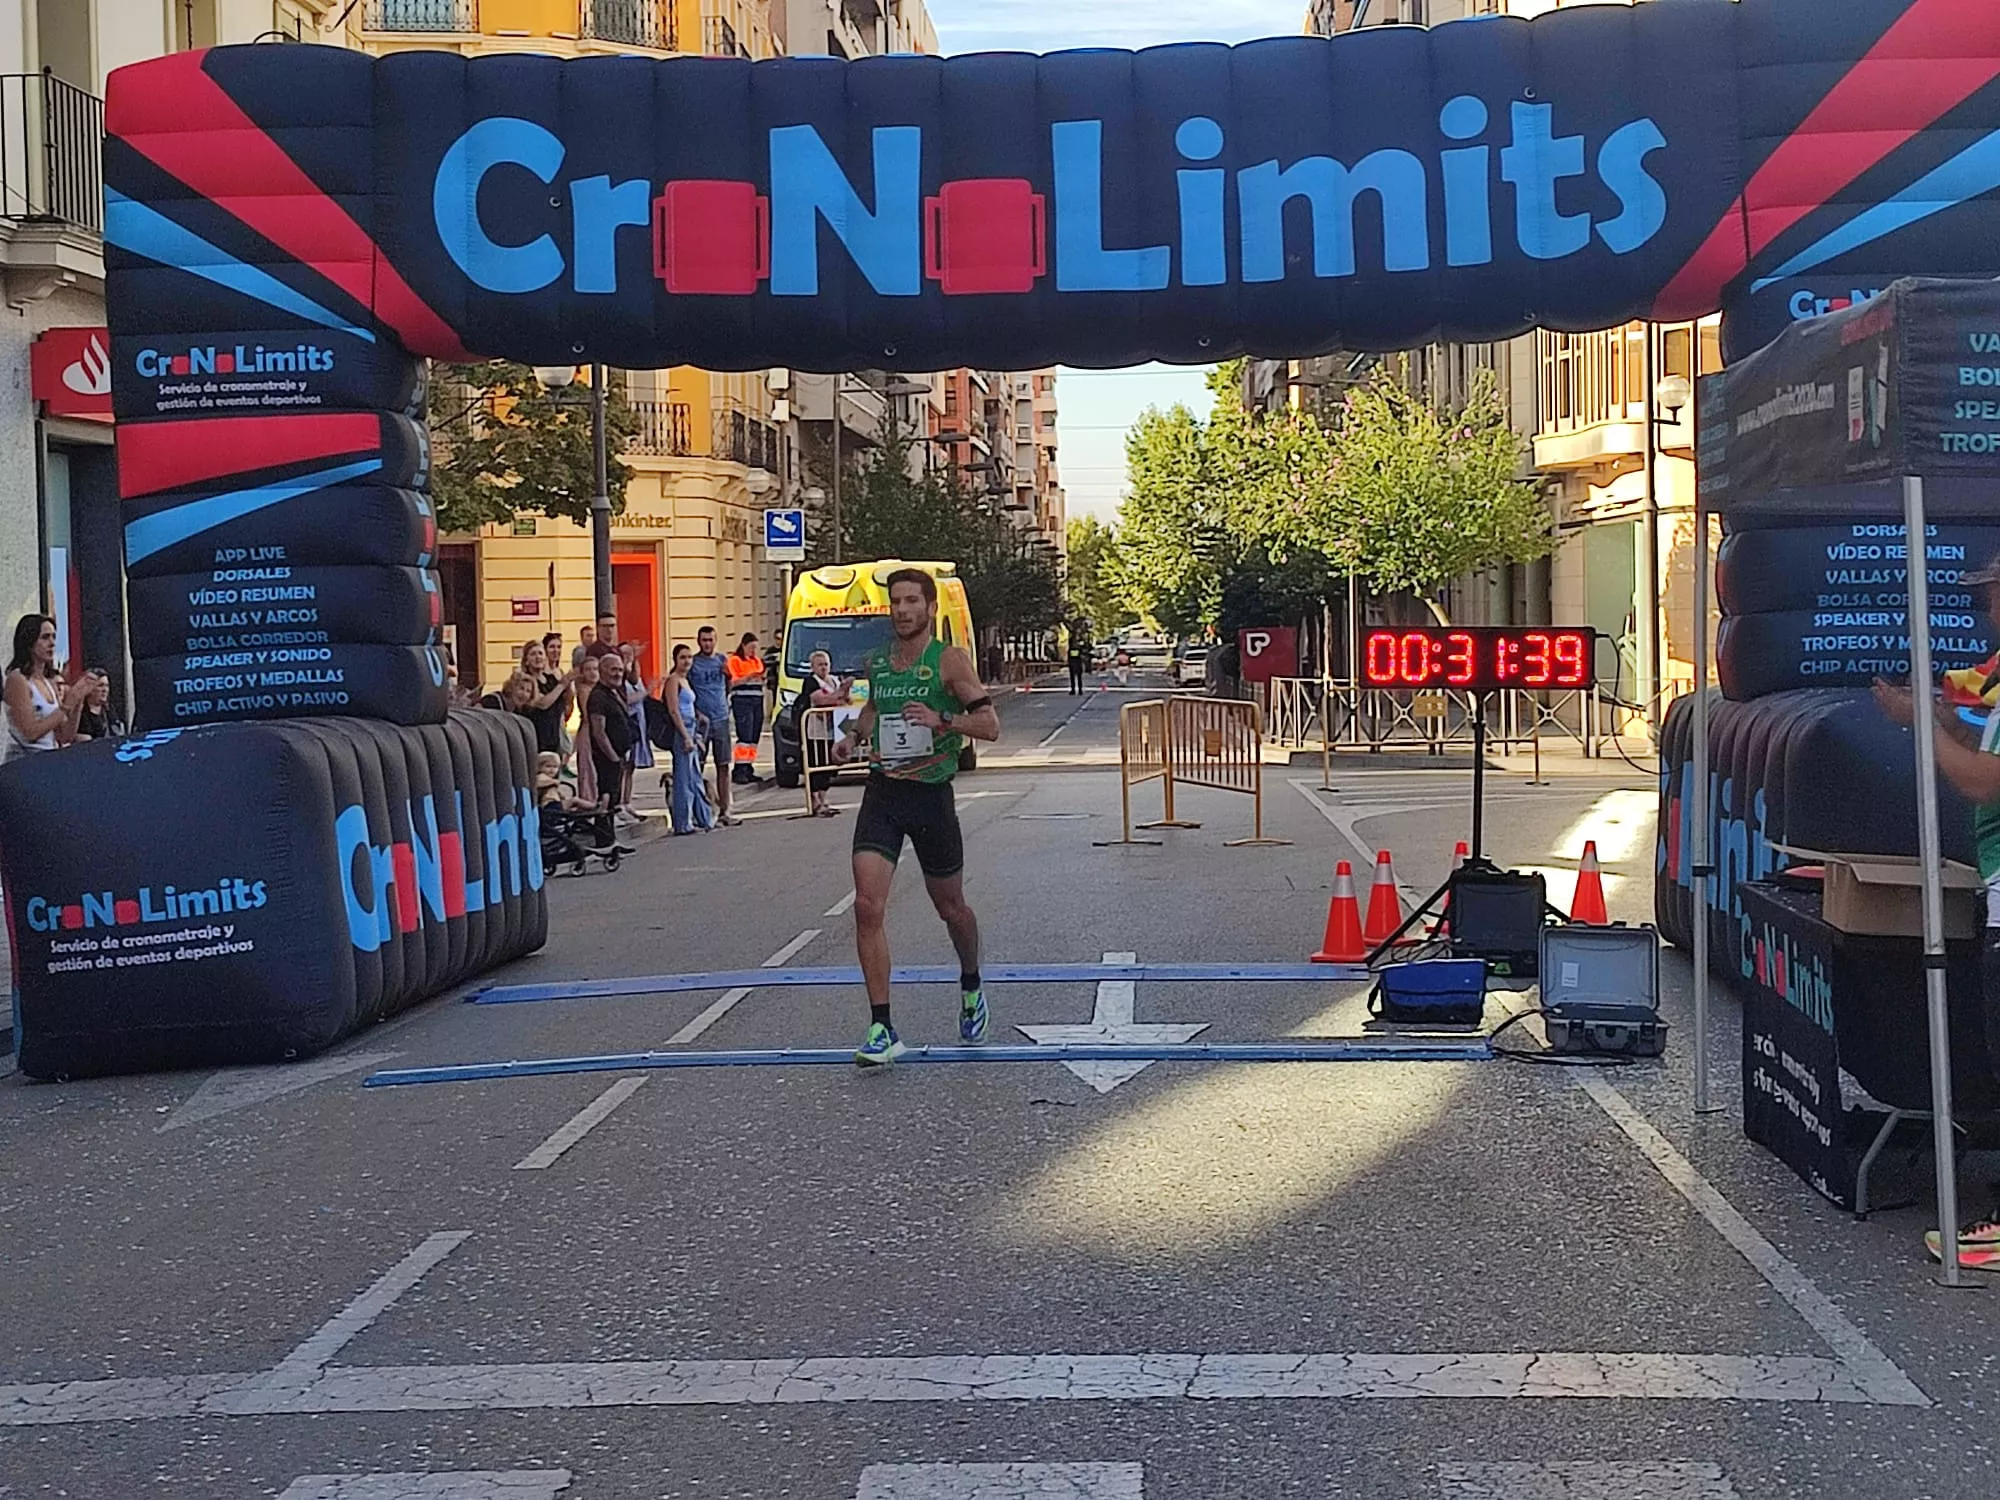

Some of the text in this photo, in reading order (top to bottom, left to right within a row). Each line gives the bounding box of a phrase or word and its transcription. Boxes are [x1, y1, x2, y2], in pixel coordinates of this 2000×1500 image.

[159, 379, 307, 395] Servicio de cronometraje y
[156, 393, 321, 411] gestión de eventos deportivos
[1852, 524, 1937, 537] DORSAES
[215, 546, 286, 563] APP LIVE
[1827, 543, 1965, 560] VÍDEO REMEN
[213, 567, 291, 582] DORSALES
[1825, 569, 1890, 584] VALLAS
[1894, 569, 1906, 583] Y
[189, 586, 315, 605] VÍDEO RESUMEN
[1817, 593, 1972, 608] BOLSA COREDOR
[189, 608, 318, 628] VALLAS Y ARCOS
[1814, 612, 1974, 629] SPEAKER Y NIDO
[186, 631, 328, 650] BOLSA CORREDOR
[1802, 635, 1879, 651] TROFEOS
[1881, 635, 1895, 650] Y
[185, 648, 331, 670] SPEAKER Y SONIDO
[1368, 633, 1583, 682] 00:31:39
[1800, 660, 1842, 674] CHIP
[1845, 658, 1909, 673] ACTIVO
[174, 669, 344, 694] TROFEOS Y MEDALLAS
[874, 685, 929, 699] Huesca
[174, 692, 349, 716] CHIP ACTIVO Y PASIVO
[896, 732, 907, 746] 3
[51, 923, 235, 954] Servicio de cronometraje y
[48, 939, 254, 974] gestión de eventos deportivos
